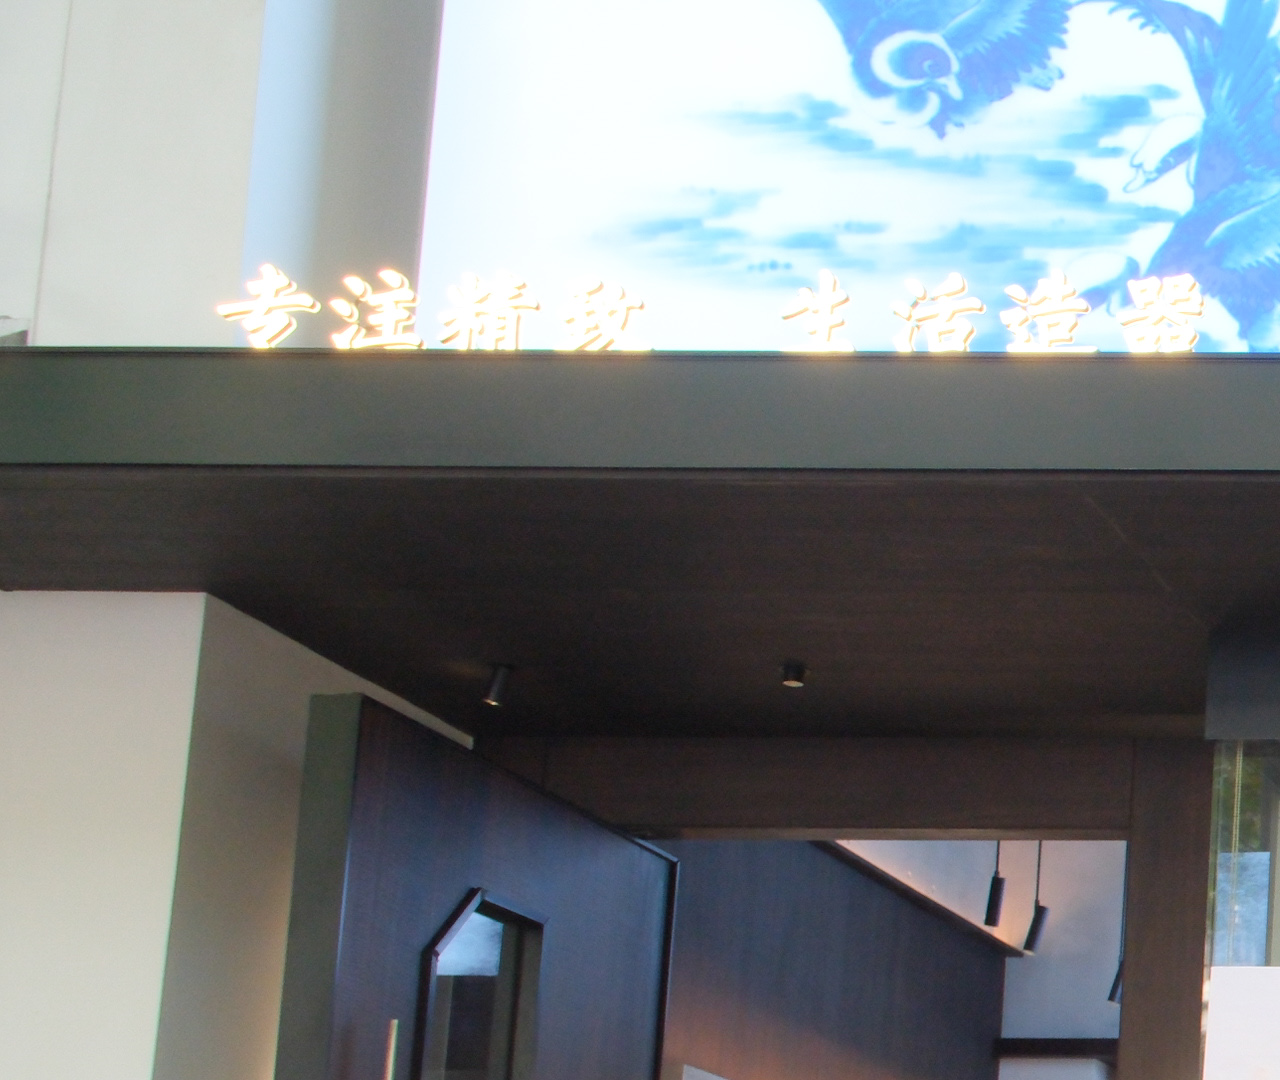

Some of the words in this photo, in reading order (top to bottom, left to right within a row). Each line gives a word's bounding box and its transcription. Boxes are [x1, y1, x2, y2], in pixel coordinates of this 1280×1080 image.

[217, 263, 648, 350] 专注精致
[780, 268, 1206, 353] 生活造器
